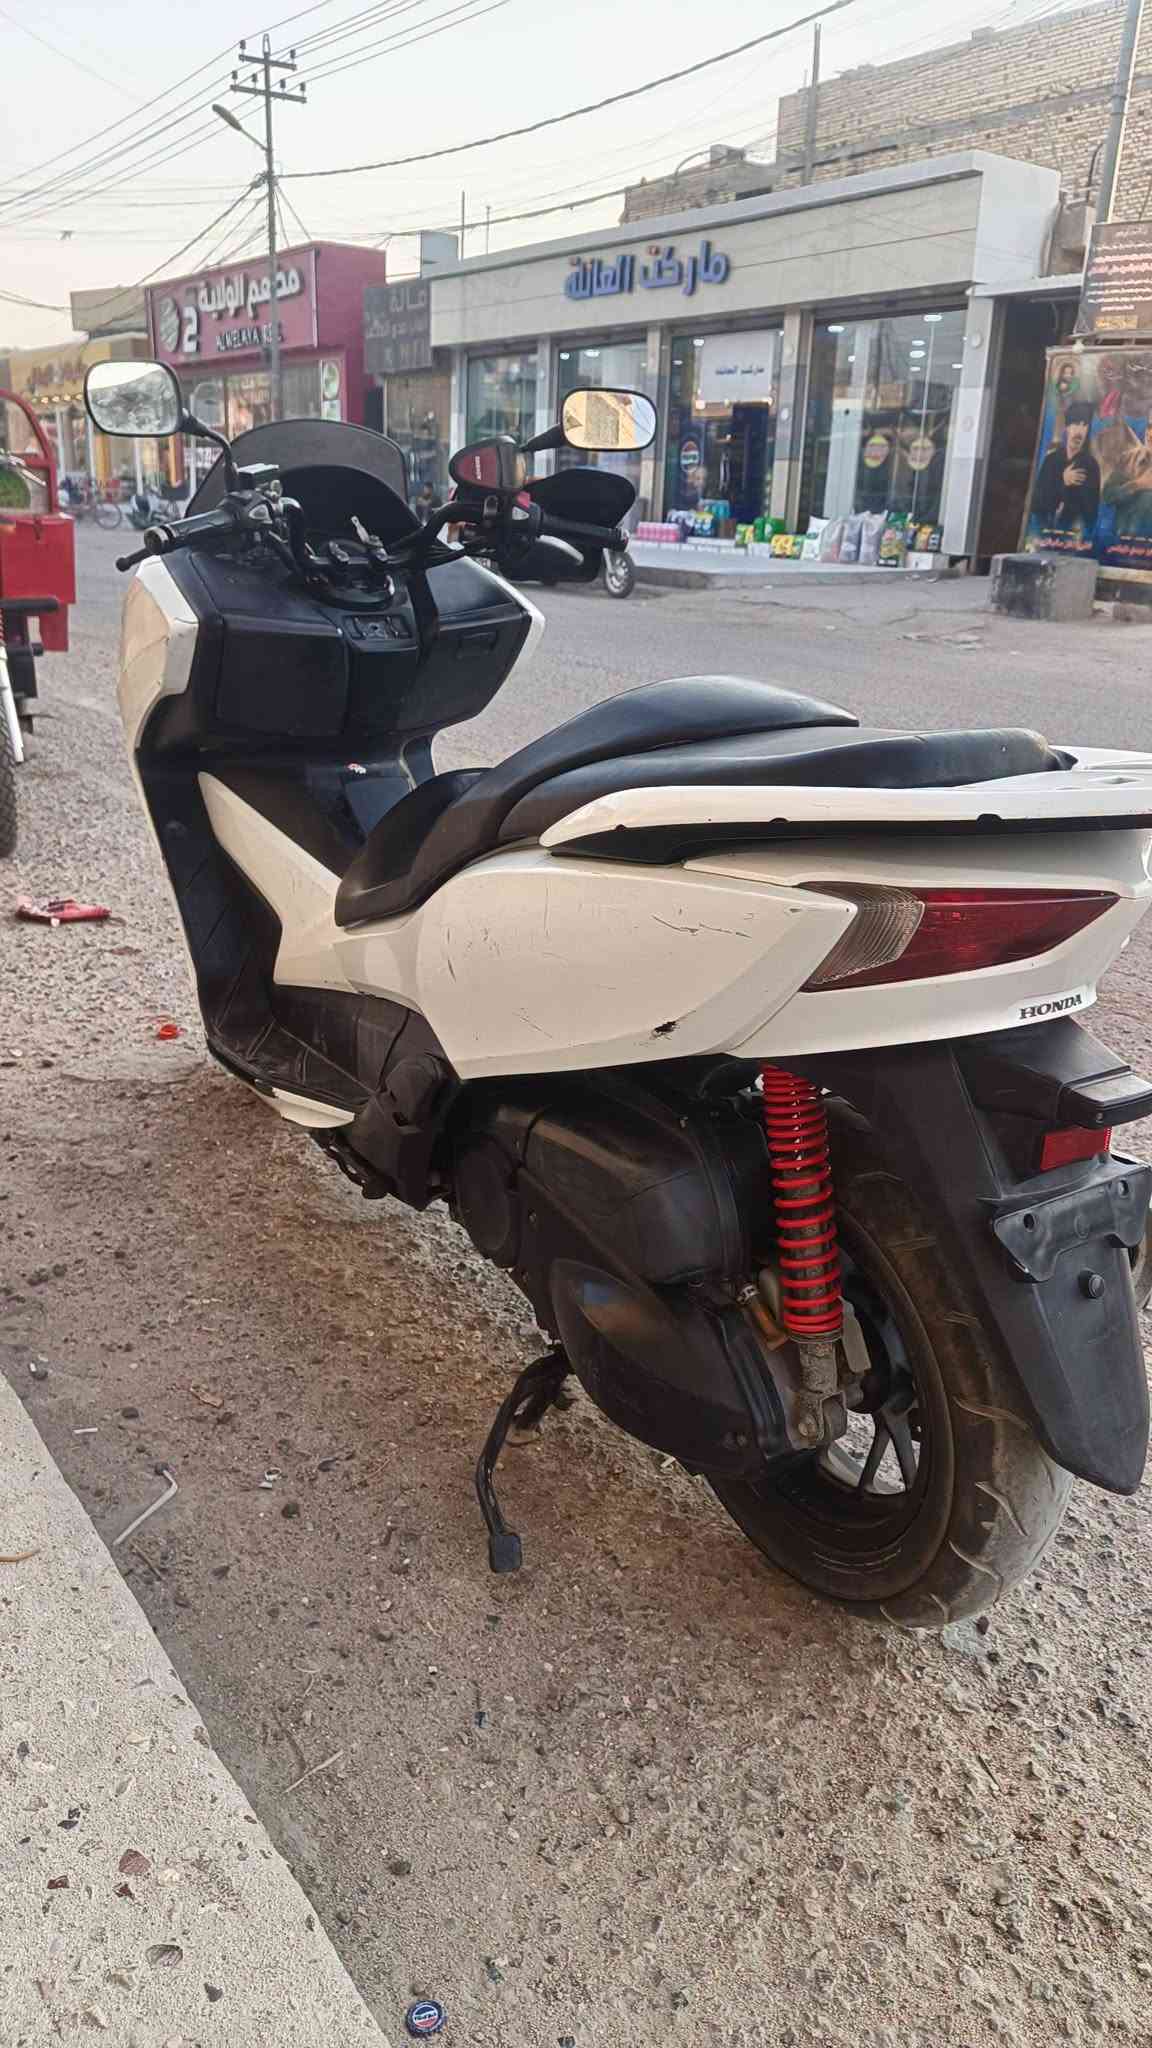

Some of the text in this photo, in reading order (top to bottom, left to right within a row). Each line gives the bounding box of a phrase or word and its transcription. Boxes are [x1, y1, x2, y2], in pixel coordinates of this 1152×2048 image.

[565, 240, 730, 301] ماركت العائلة
[182, 304, 199, 353] 2
[1019, 994, 1083, 1019] HONDA
